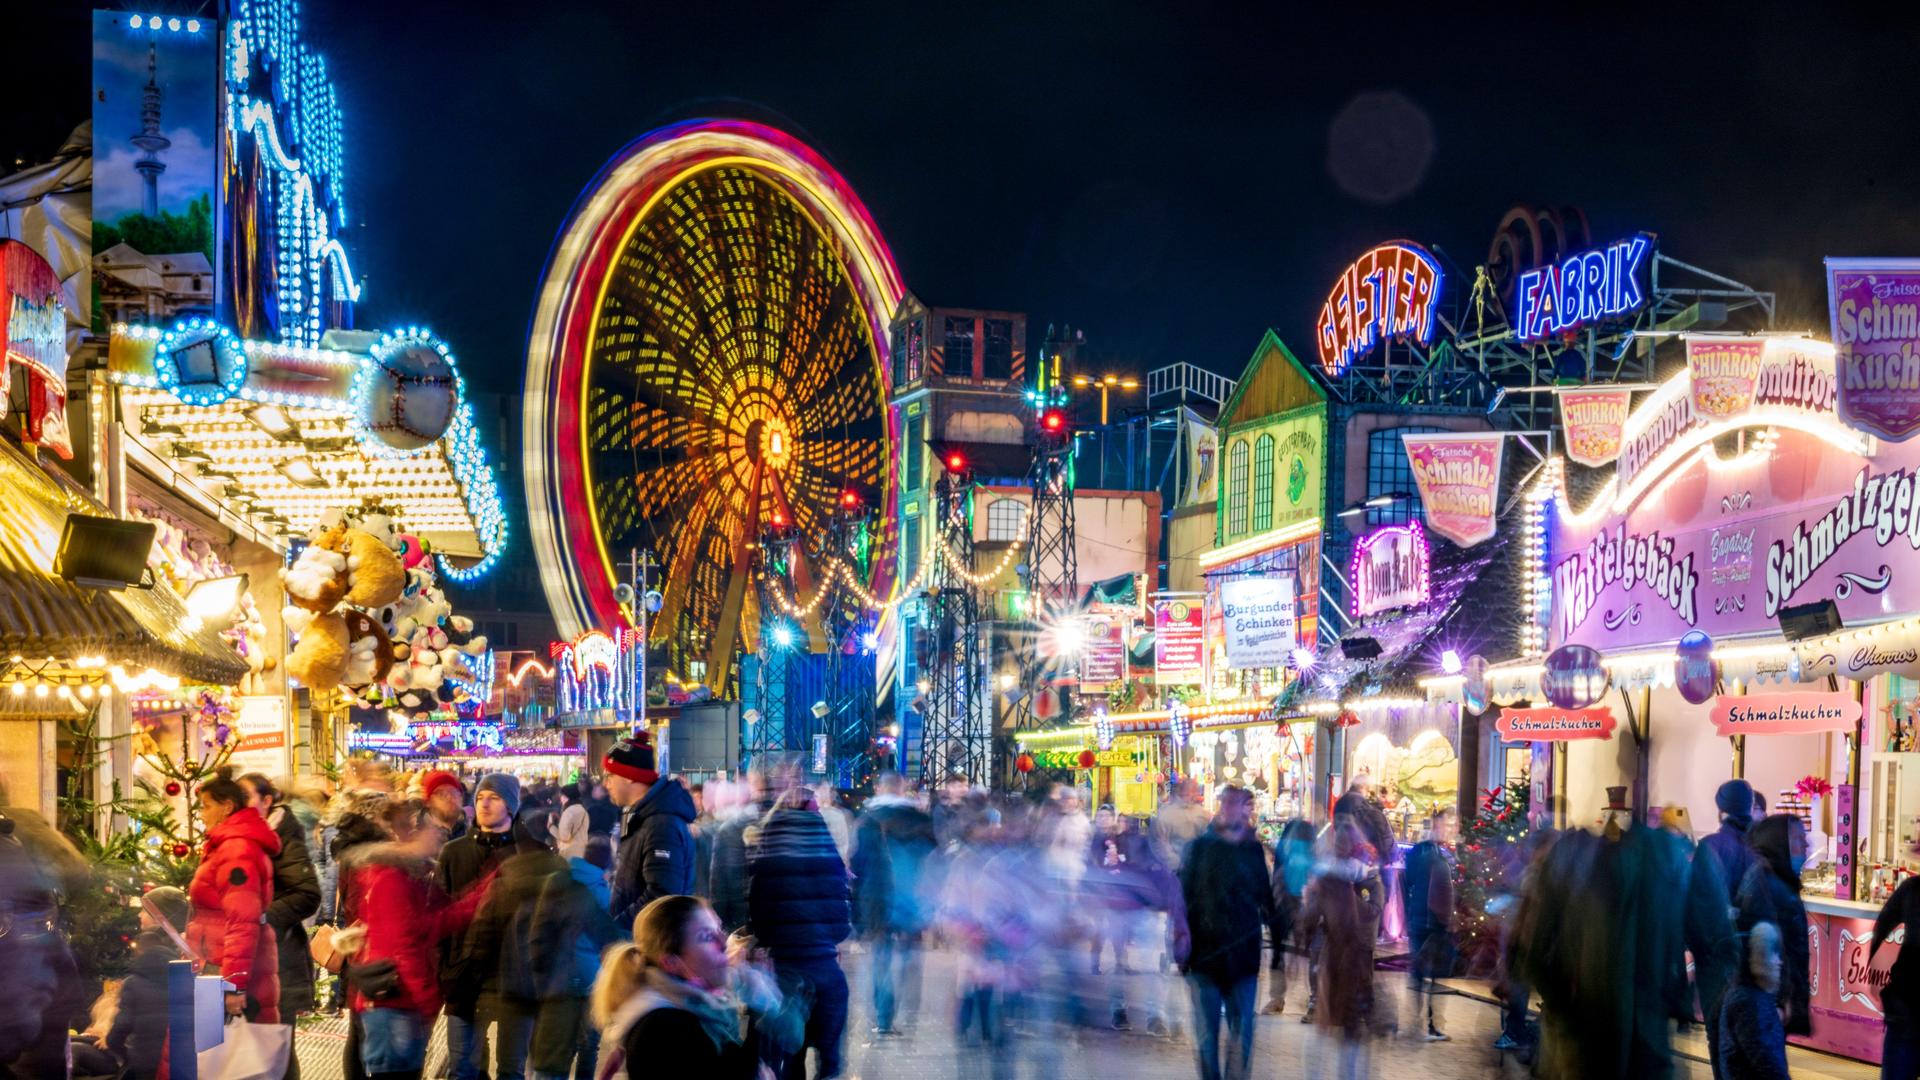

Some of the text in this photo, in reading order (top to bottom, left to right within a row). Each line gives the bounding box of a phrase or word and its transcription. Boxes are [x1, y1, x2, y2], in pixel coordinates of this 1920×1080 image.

[1517, 237, 1647, 340] FABRIK
[1316, 243, 1442, 378] GEISTER
[1839, 297, 1920, 345] Schm
[1690, 351, 1761, 381] CHURROS
[1564, 402, 1626, 428] CHURROS
[1414, 455, 1495, 489] Schmalz-
[1423, 485, 1491, 512] kuchen
[1555, 520, 1699, 644] Waffelgebäck
[1225, 601, 1293, 618] Burgunder
[1236, 617, 1293, 632] Schinken
[1848, 645, 1918, 672] Churros
[1511, 716, 1602, 731] Schmalzkuchen
[1727, 703, 1842, 724] Schmalzkuchen
